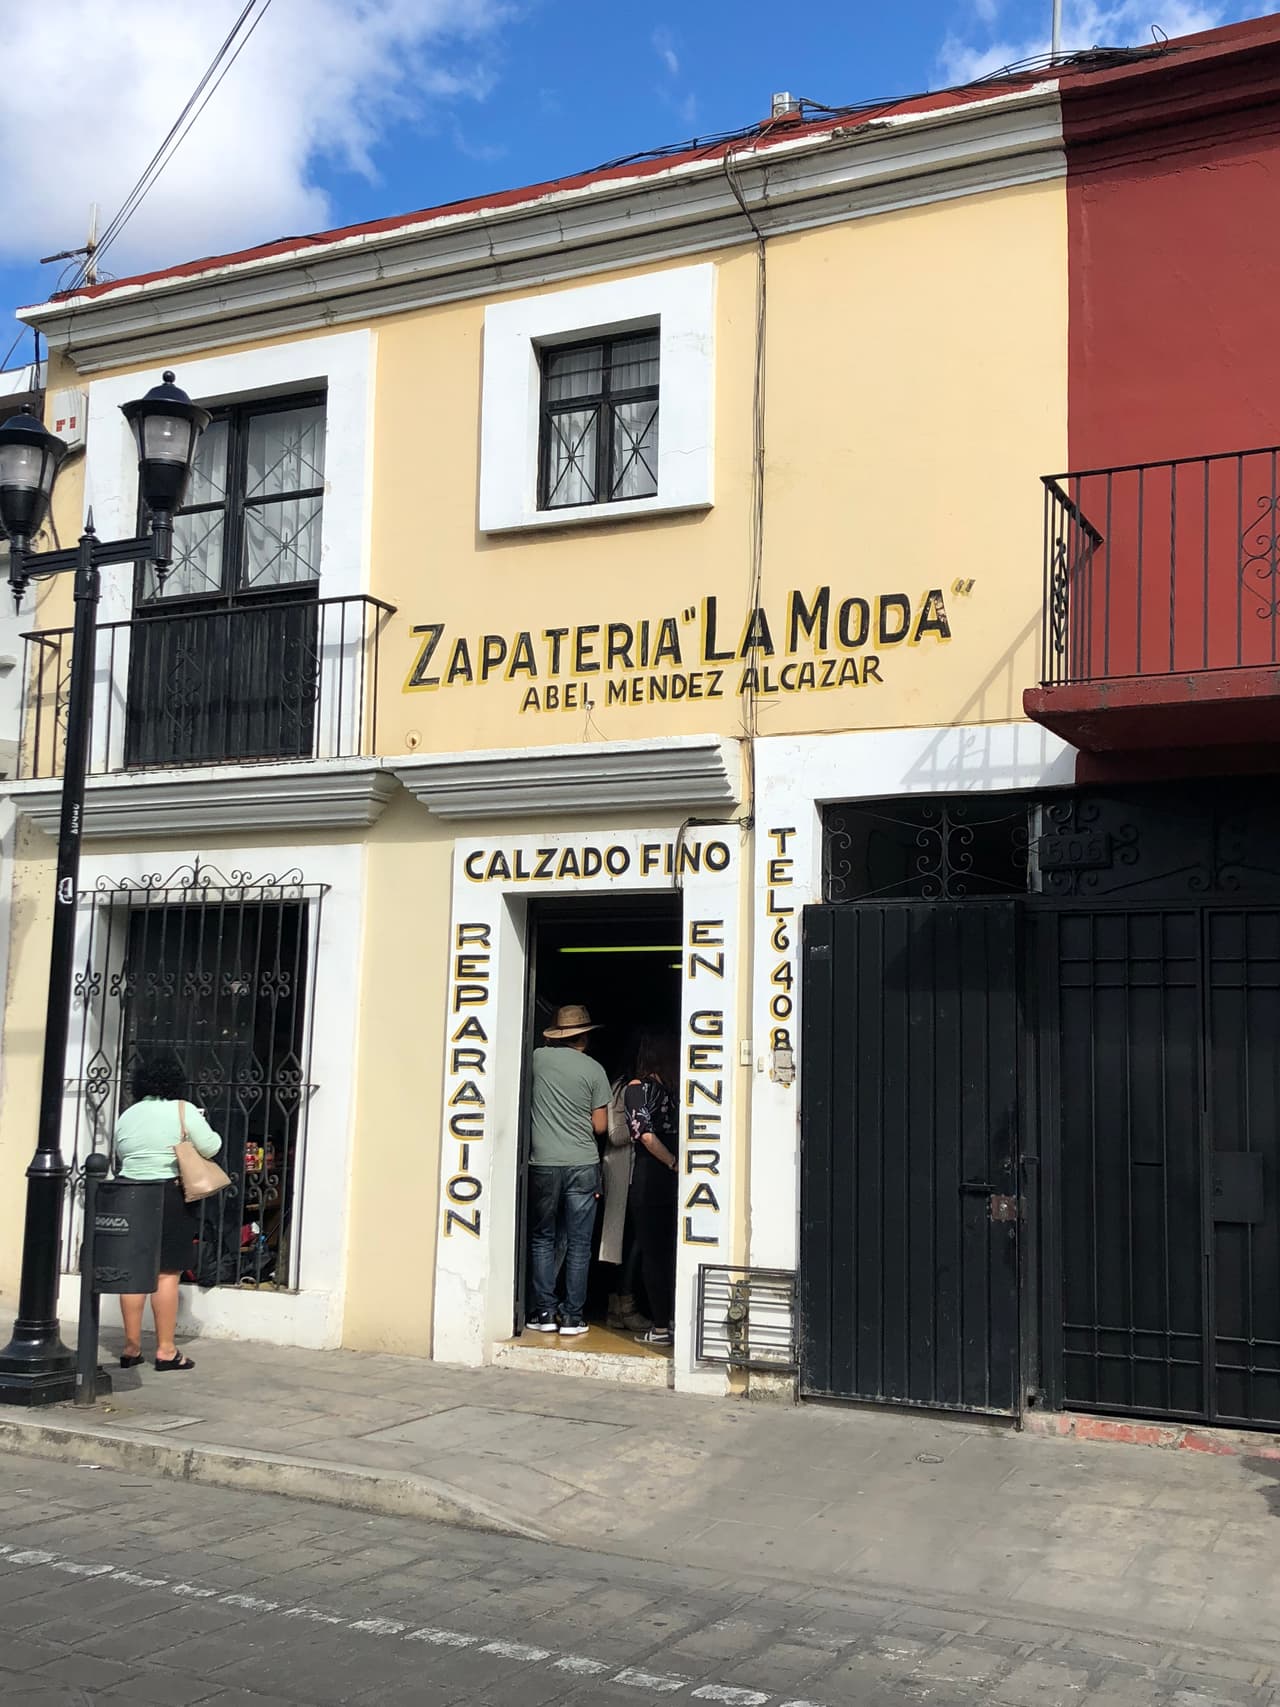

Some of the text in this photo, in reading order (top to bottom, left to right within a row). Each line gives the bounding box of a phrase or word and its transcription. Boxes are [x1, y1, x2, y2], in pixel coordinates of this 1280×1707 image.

[402, 616, 683, 693] ZAPATERIA
[519, 655, 885, 713] ABEL MENDEZ ALCAZAR
[464, 840, 731, 883] CALZADO FINO
[444, 922, 492, 1240] REPARACION
[683, 919, 724, 1247] EN GENERAL
